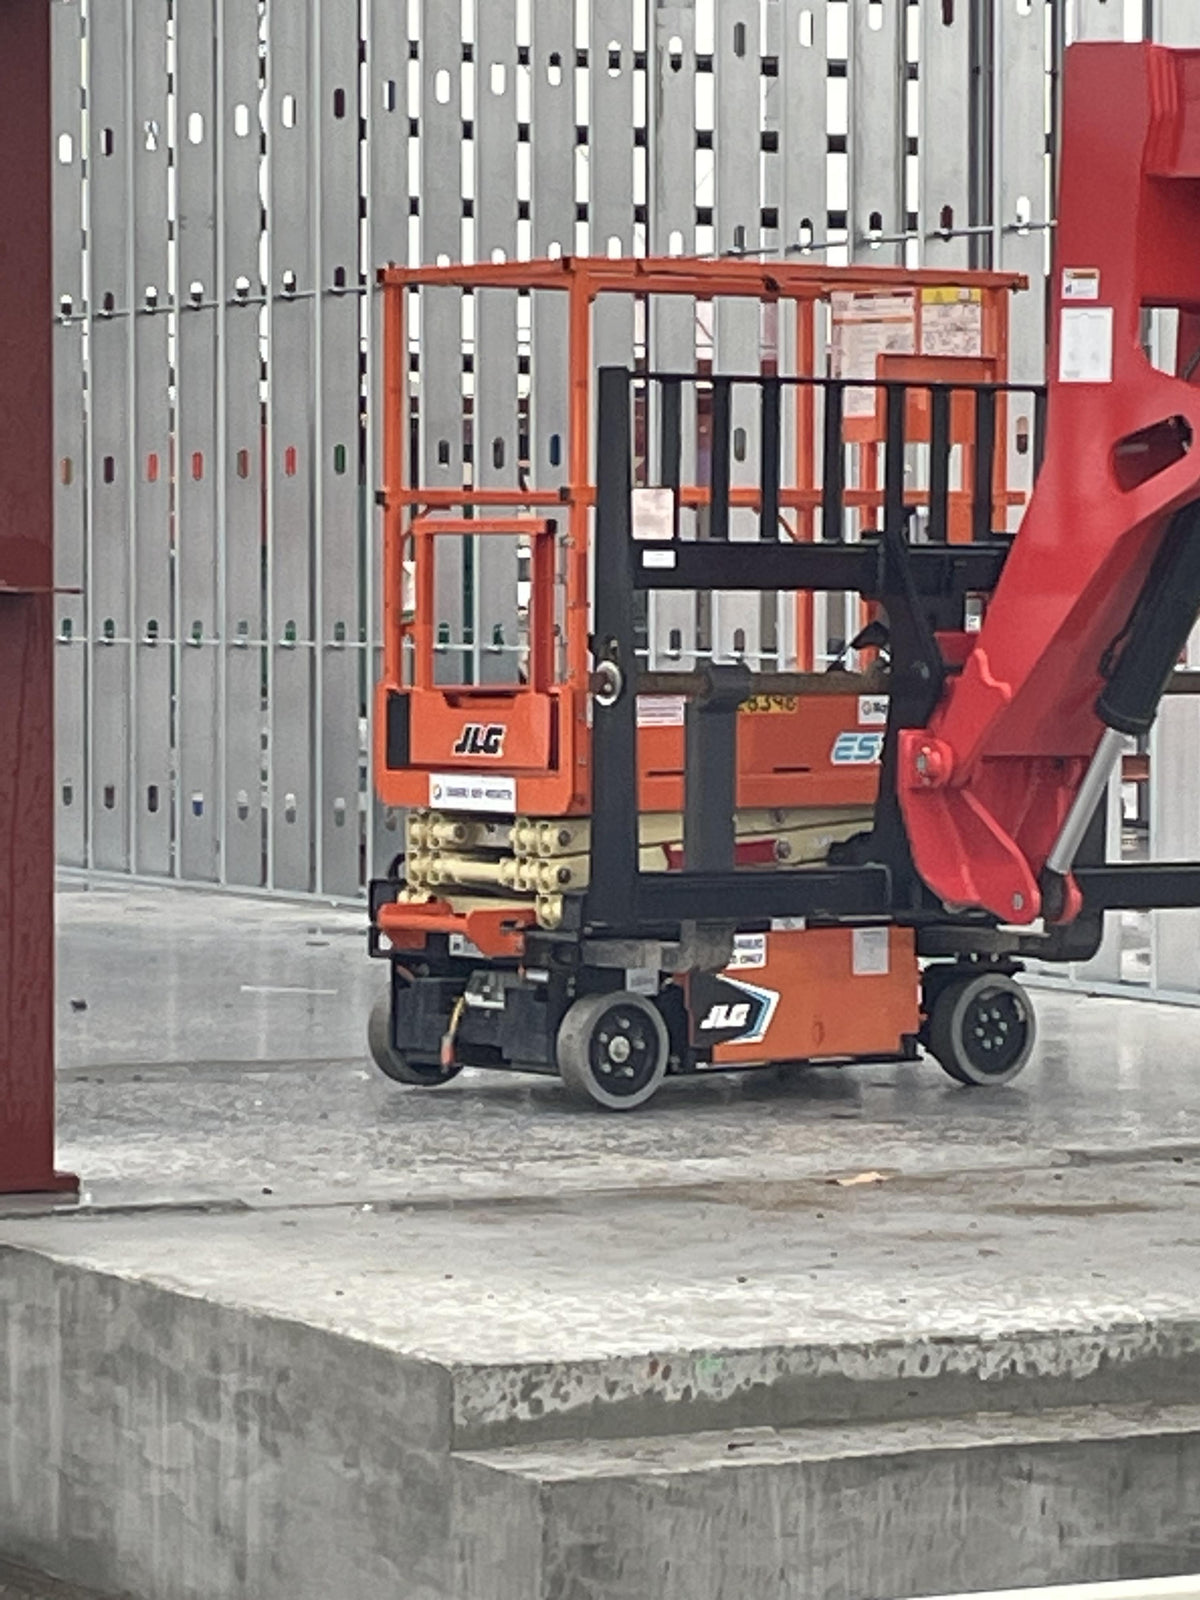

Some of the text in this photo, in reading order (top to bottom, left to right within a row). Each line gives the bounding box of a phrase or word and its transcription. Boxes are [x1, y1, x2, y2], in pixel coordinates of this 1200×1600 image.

[454, 725, 504, 755] JLG
[834, 735, 880, 761] ES
[699, 1003, 752, 1030] JLG
